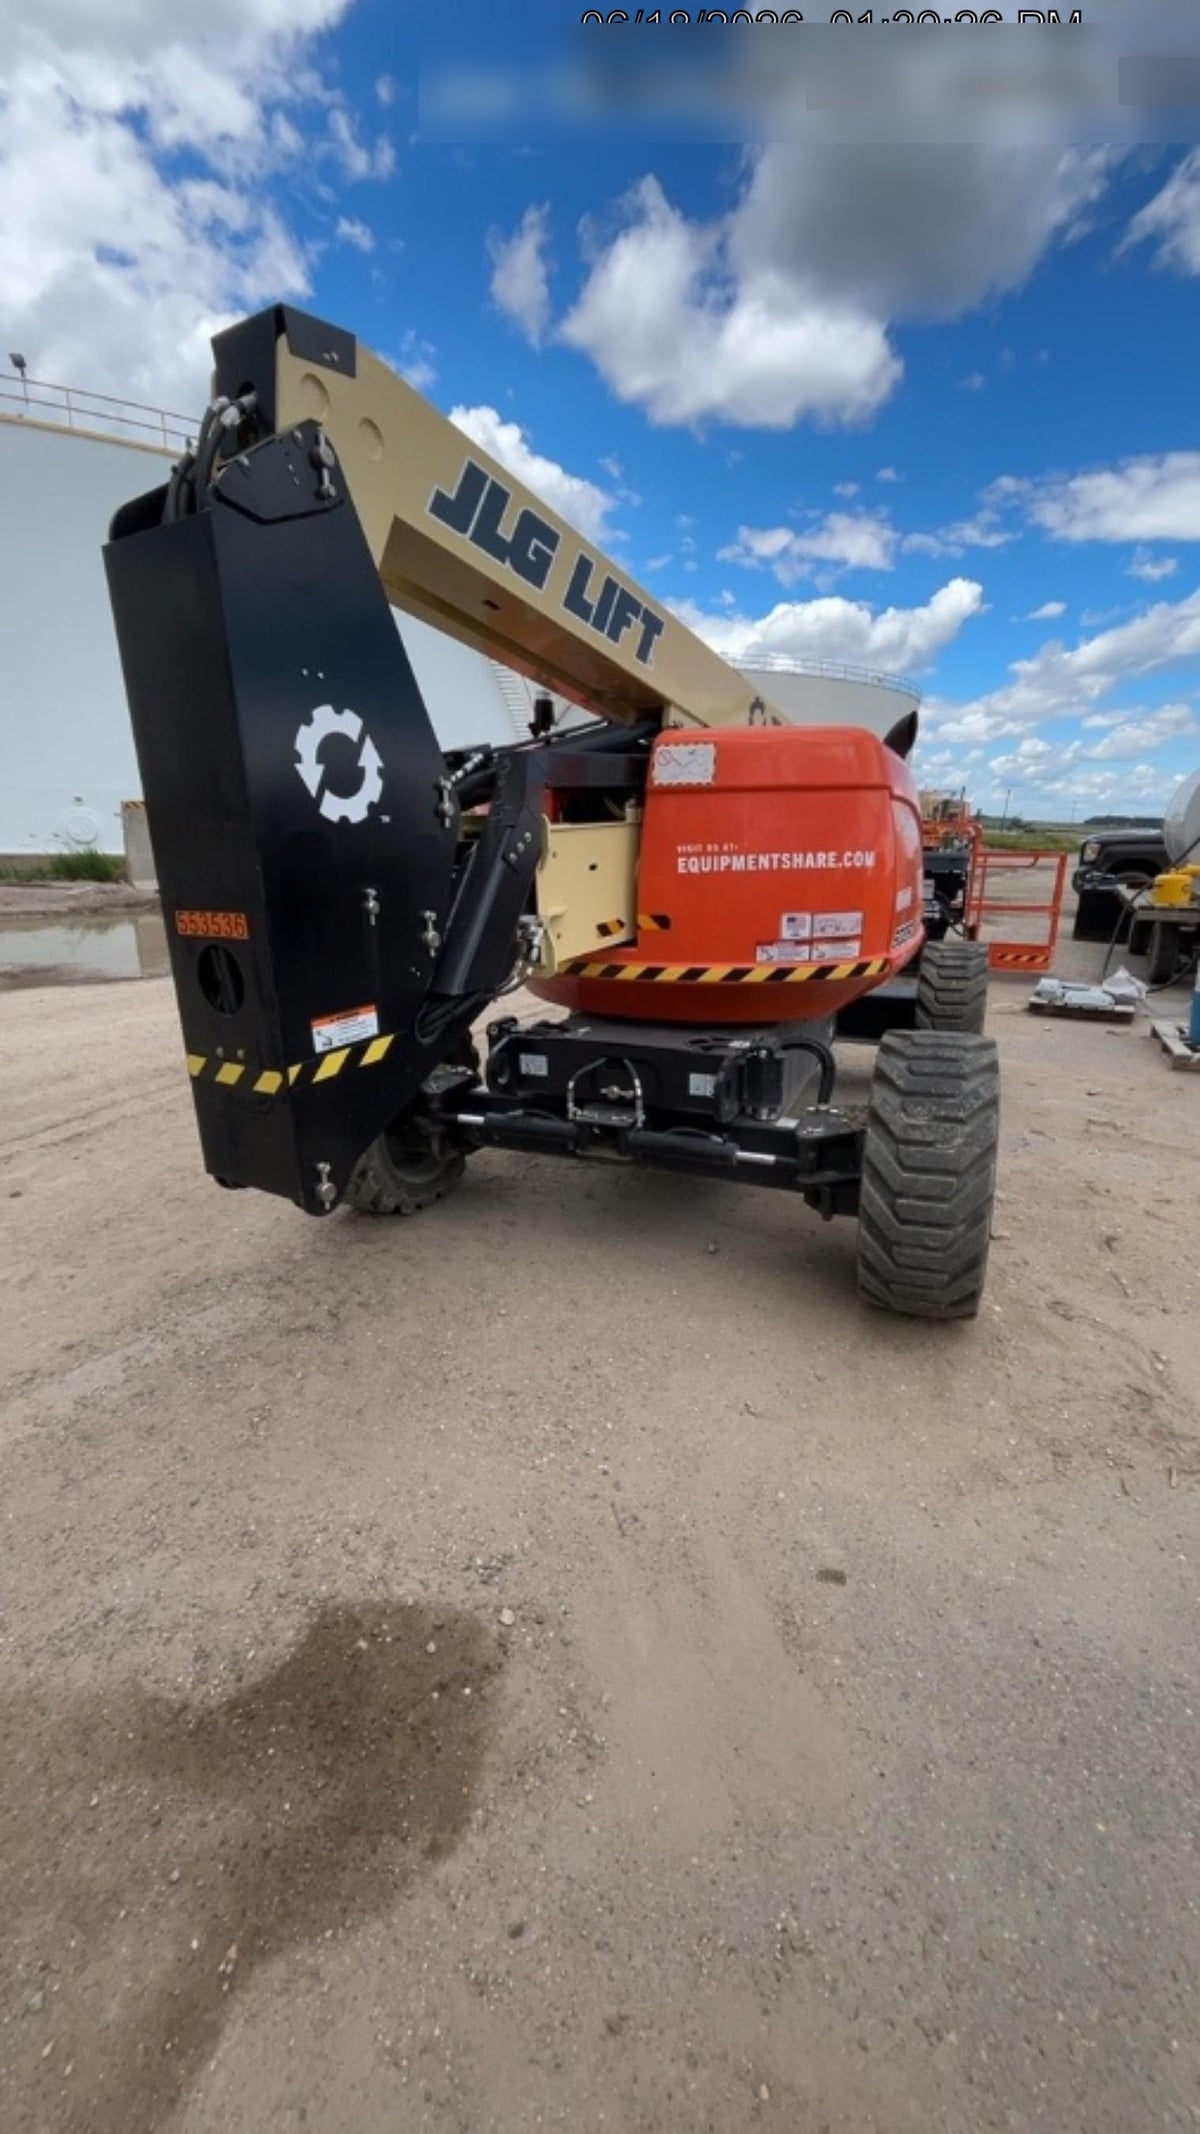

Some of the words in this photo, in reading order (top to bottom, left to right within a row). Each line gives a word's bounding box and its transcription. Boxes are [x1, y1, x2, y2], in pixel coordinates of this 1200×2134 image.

[425, 457, 561, 593] JLG
[562, 552, 666, 668] LIFT
[677, 850, 876, 873] EQUIPMENTSHARE.COM
[178, 912, 245, 937] 553536
